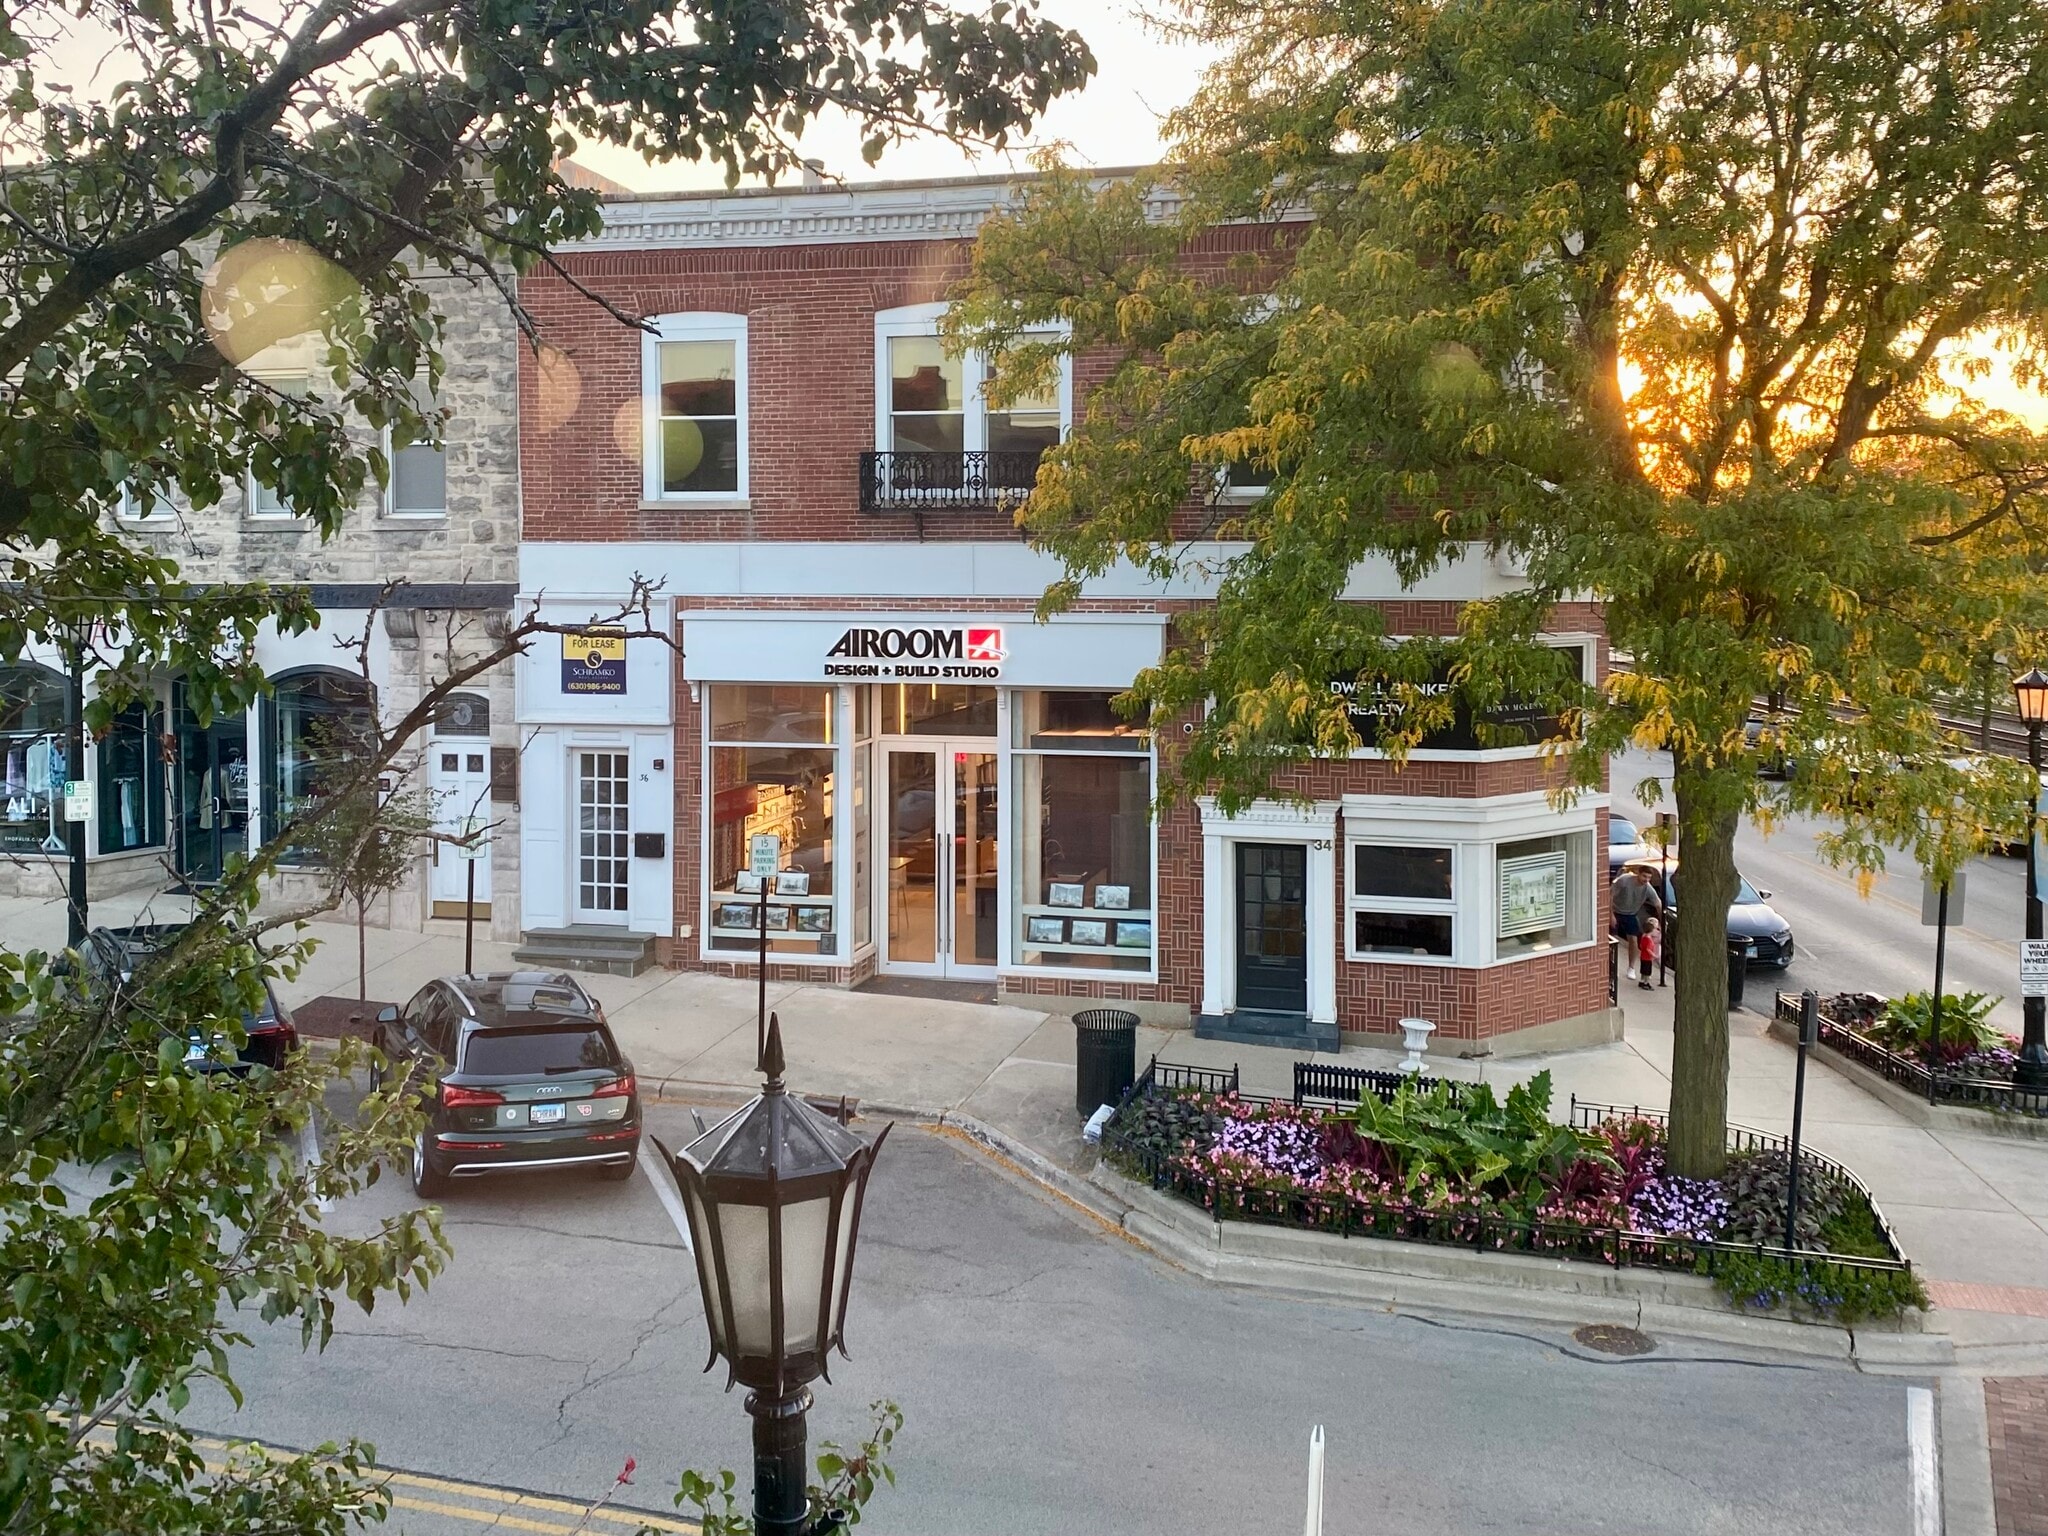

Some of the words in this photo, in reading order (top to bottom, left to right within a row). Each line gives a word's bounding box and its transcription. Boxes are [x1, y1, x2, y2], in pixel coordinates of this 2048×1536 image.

[572, 639, 589, 649] FOR
[590, 639, 616, 649] LEASE
[825, 628, 963, 659] AIROOM
[572, 667, 616, 676] SCHRAMKO
[824, 664, 879, 677] DESIGN
[894, 665, 940, 678] BUILD
[942, 666, 999, 679] STUDIO
[567, 682, 621, 691] (630)986-9400
[1348, 702, 1407, 717] REALTY
[1512, 702, 1548, 712] MCKENN
[761, 839, 769, 848] 15
[1314, 839, 1332, 852] 34
